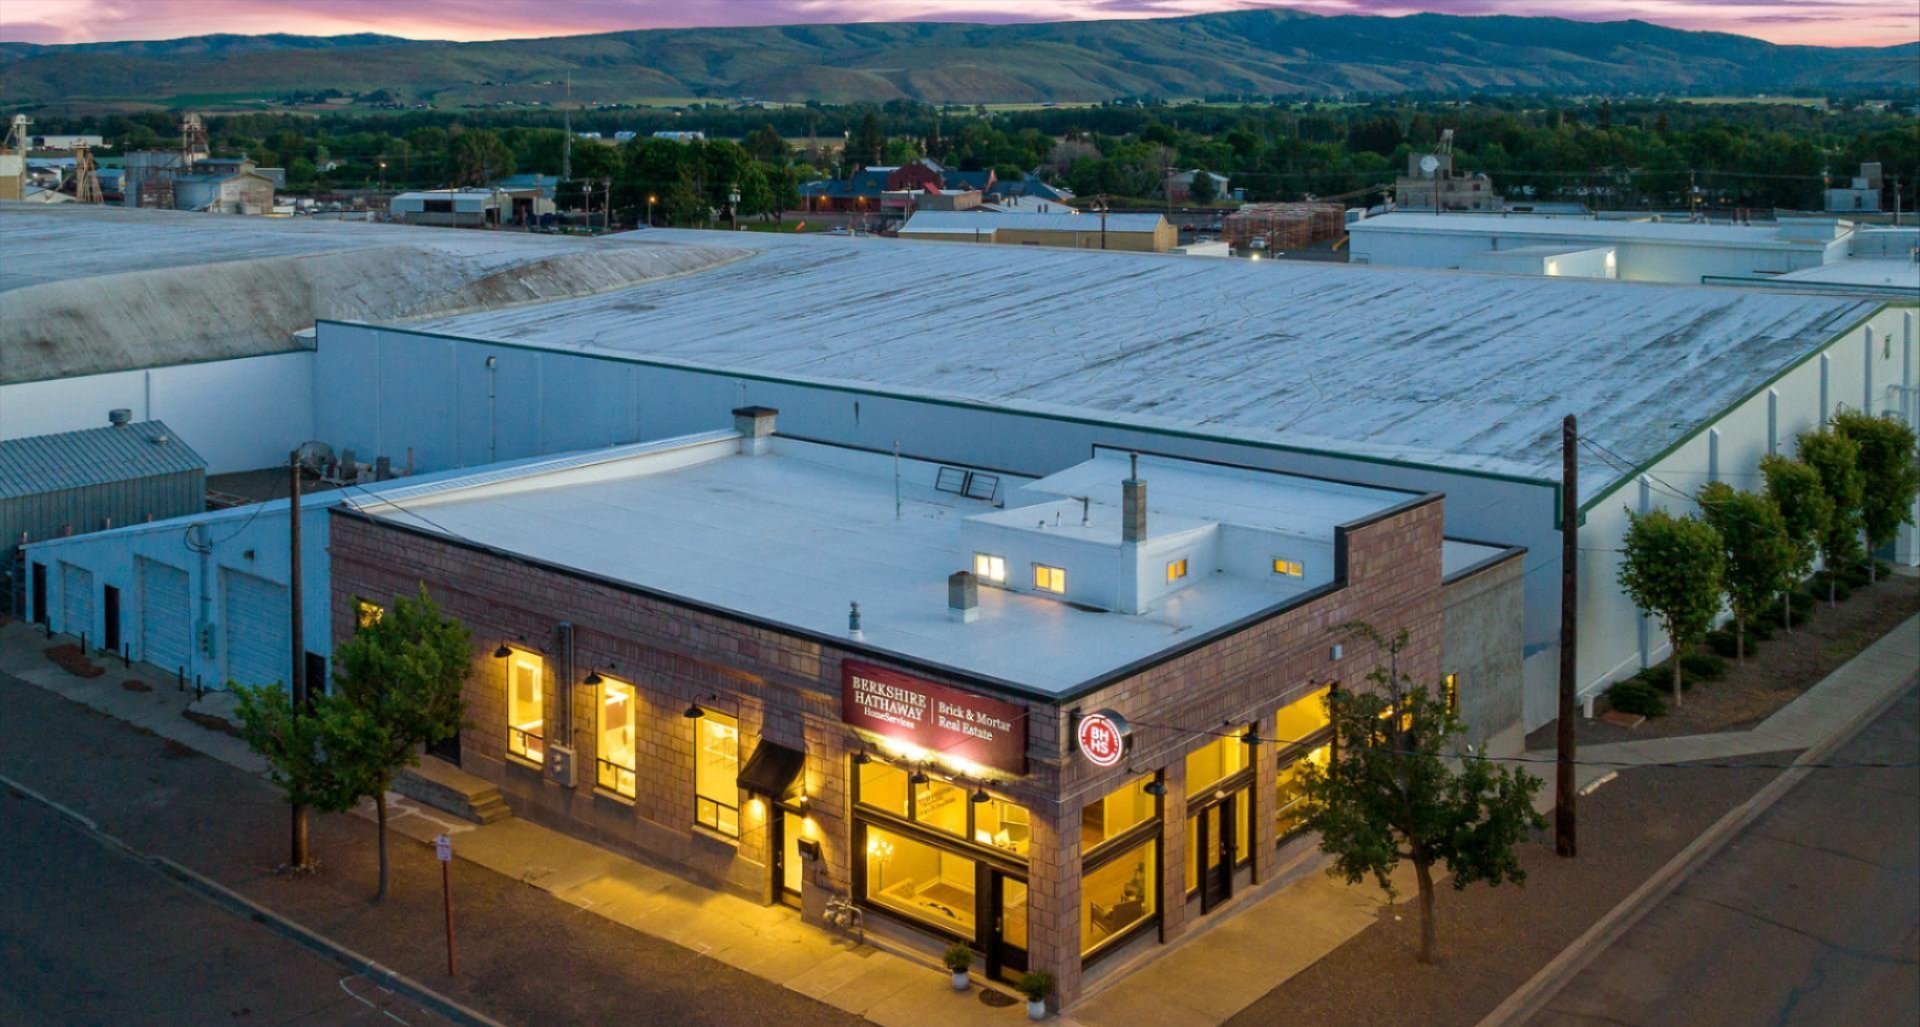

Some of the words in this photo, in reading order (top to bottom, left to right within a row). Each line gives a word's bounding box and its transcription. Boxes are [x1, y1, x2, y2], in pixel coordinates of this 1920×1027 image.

[852, 676, 926, 708] BERKSHIRE
[854, 690, 924, 720] HATHAWAY
[864, 707, 915, 729] HomeServices
[938, 701, 964, 719] Brick
[966, 709, 975, 722] &
[976, 712, 1012, 733] Mortar
[938, 715, 961, 733] Real
[962, 723, 993, 741] Estate
[1091, 725, 1110, 742] BH
[1091, 738, 1110, 754] HS
